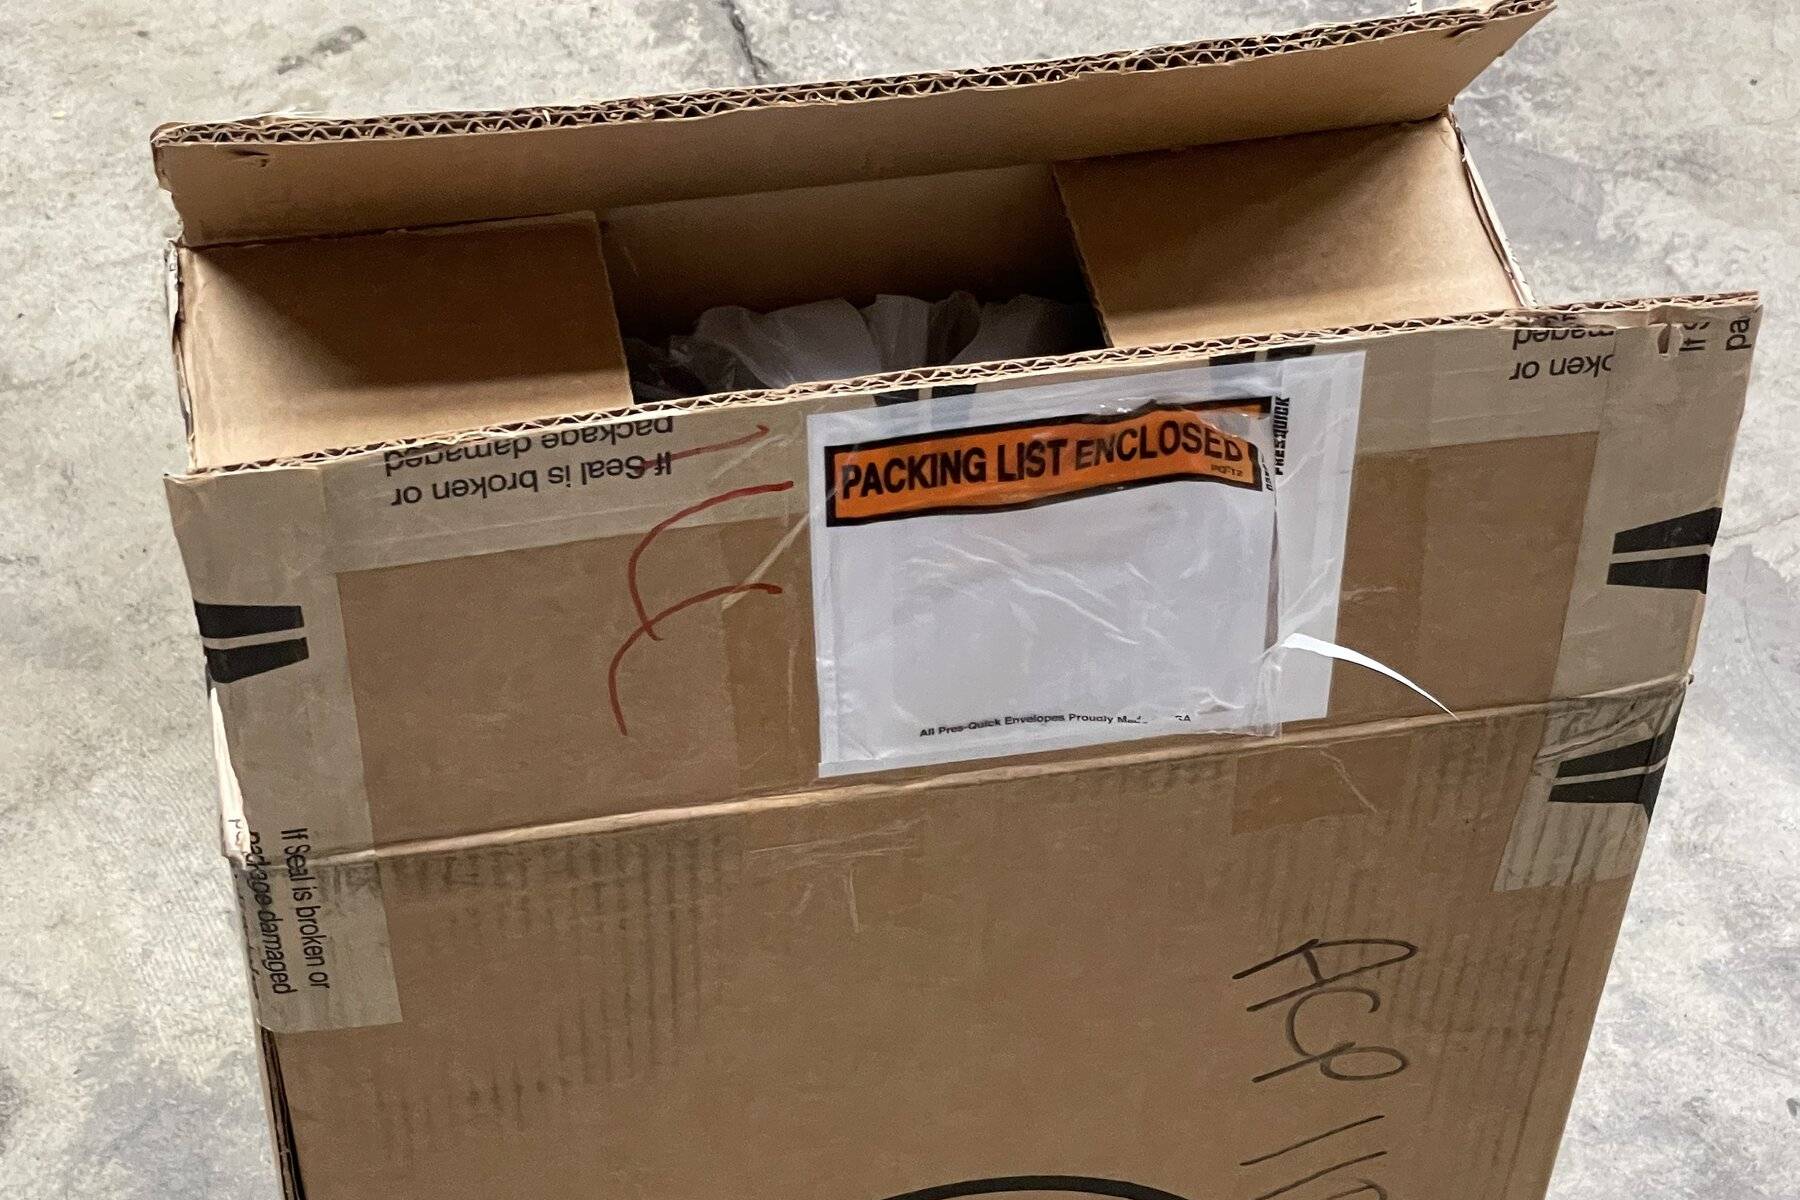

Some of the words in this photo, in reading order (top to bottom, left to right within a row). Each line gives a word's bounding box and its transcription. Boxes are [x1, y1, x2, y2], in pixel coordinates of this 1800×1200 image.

[1508, 361, 1540, 381] or
[540, 415, 675, 449] package
[582, 456, 647, 486] Seal
[654, 451, 673, 475] If
[841, 447, 988, 499] PACKING
[997, 437, 1069, 484] LIST
[1074, 419, 1243, 470] ENCLOSED
[432, 469, 540, 499] broken
[548, 466, 571, 488] is
[390, 485, 423, 506] or
[919, 727, 936, 737] All
[937, 718, 1001, 736] Pres-Quick
[1004, 713, 1066, 725] Envelopes
[1068, 713, 1114, 725] Proudly
[281, 828, 309, 840] If
[284, 843, 316, 881] Seal
[292, 886, 318, 901] is
[295, 905, 328, 967] broken
[257, 910, 298, 994] damaged
[308, 971, 330, 989] or
